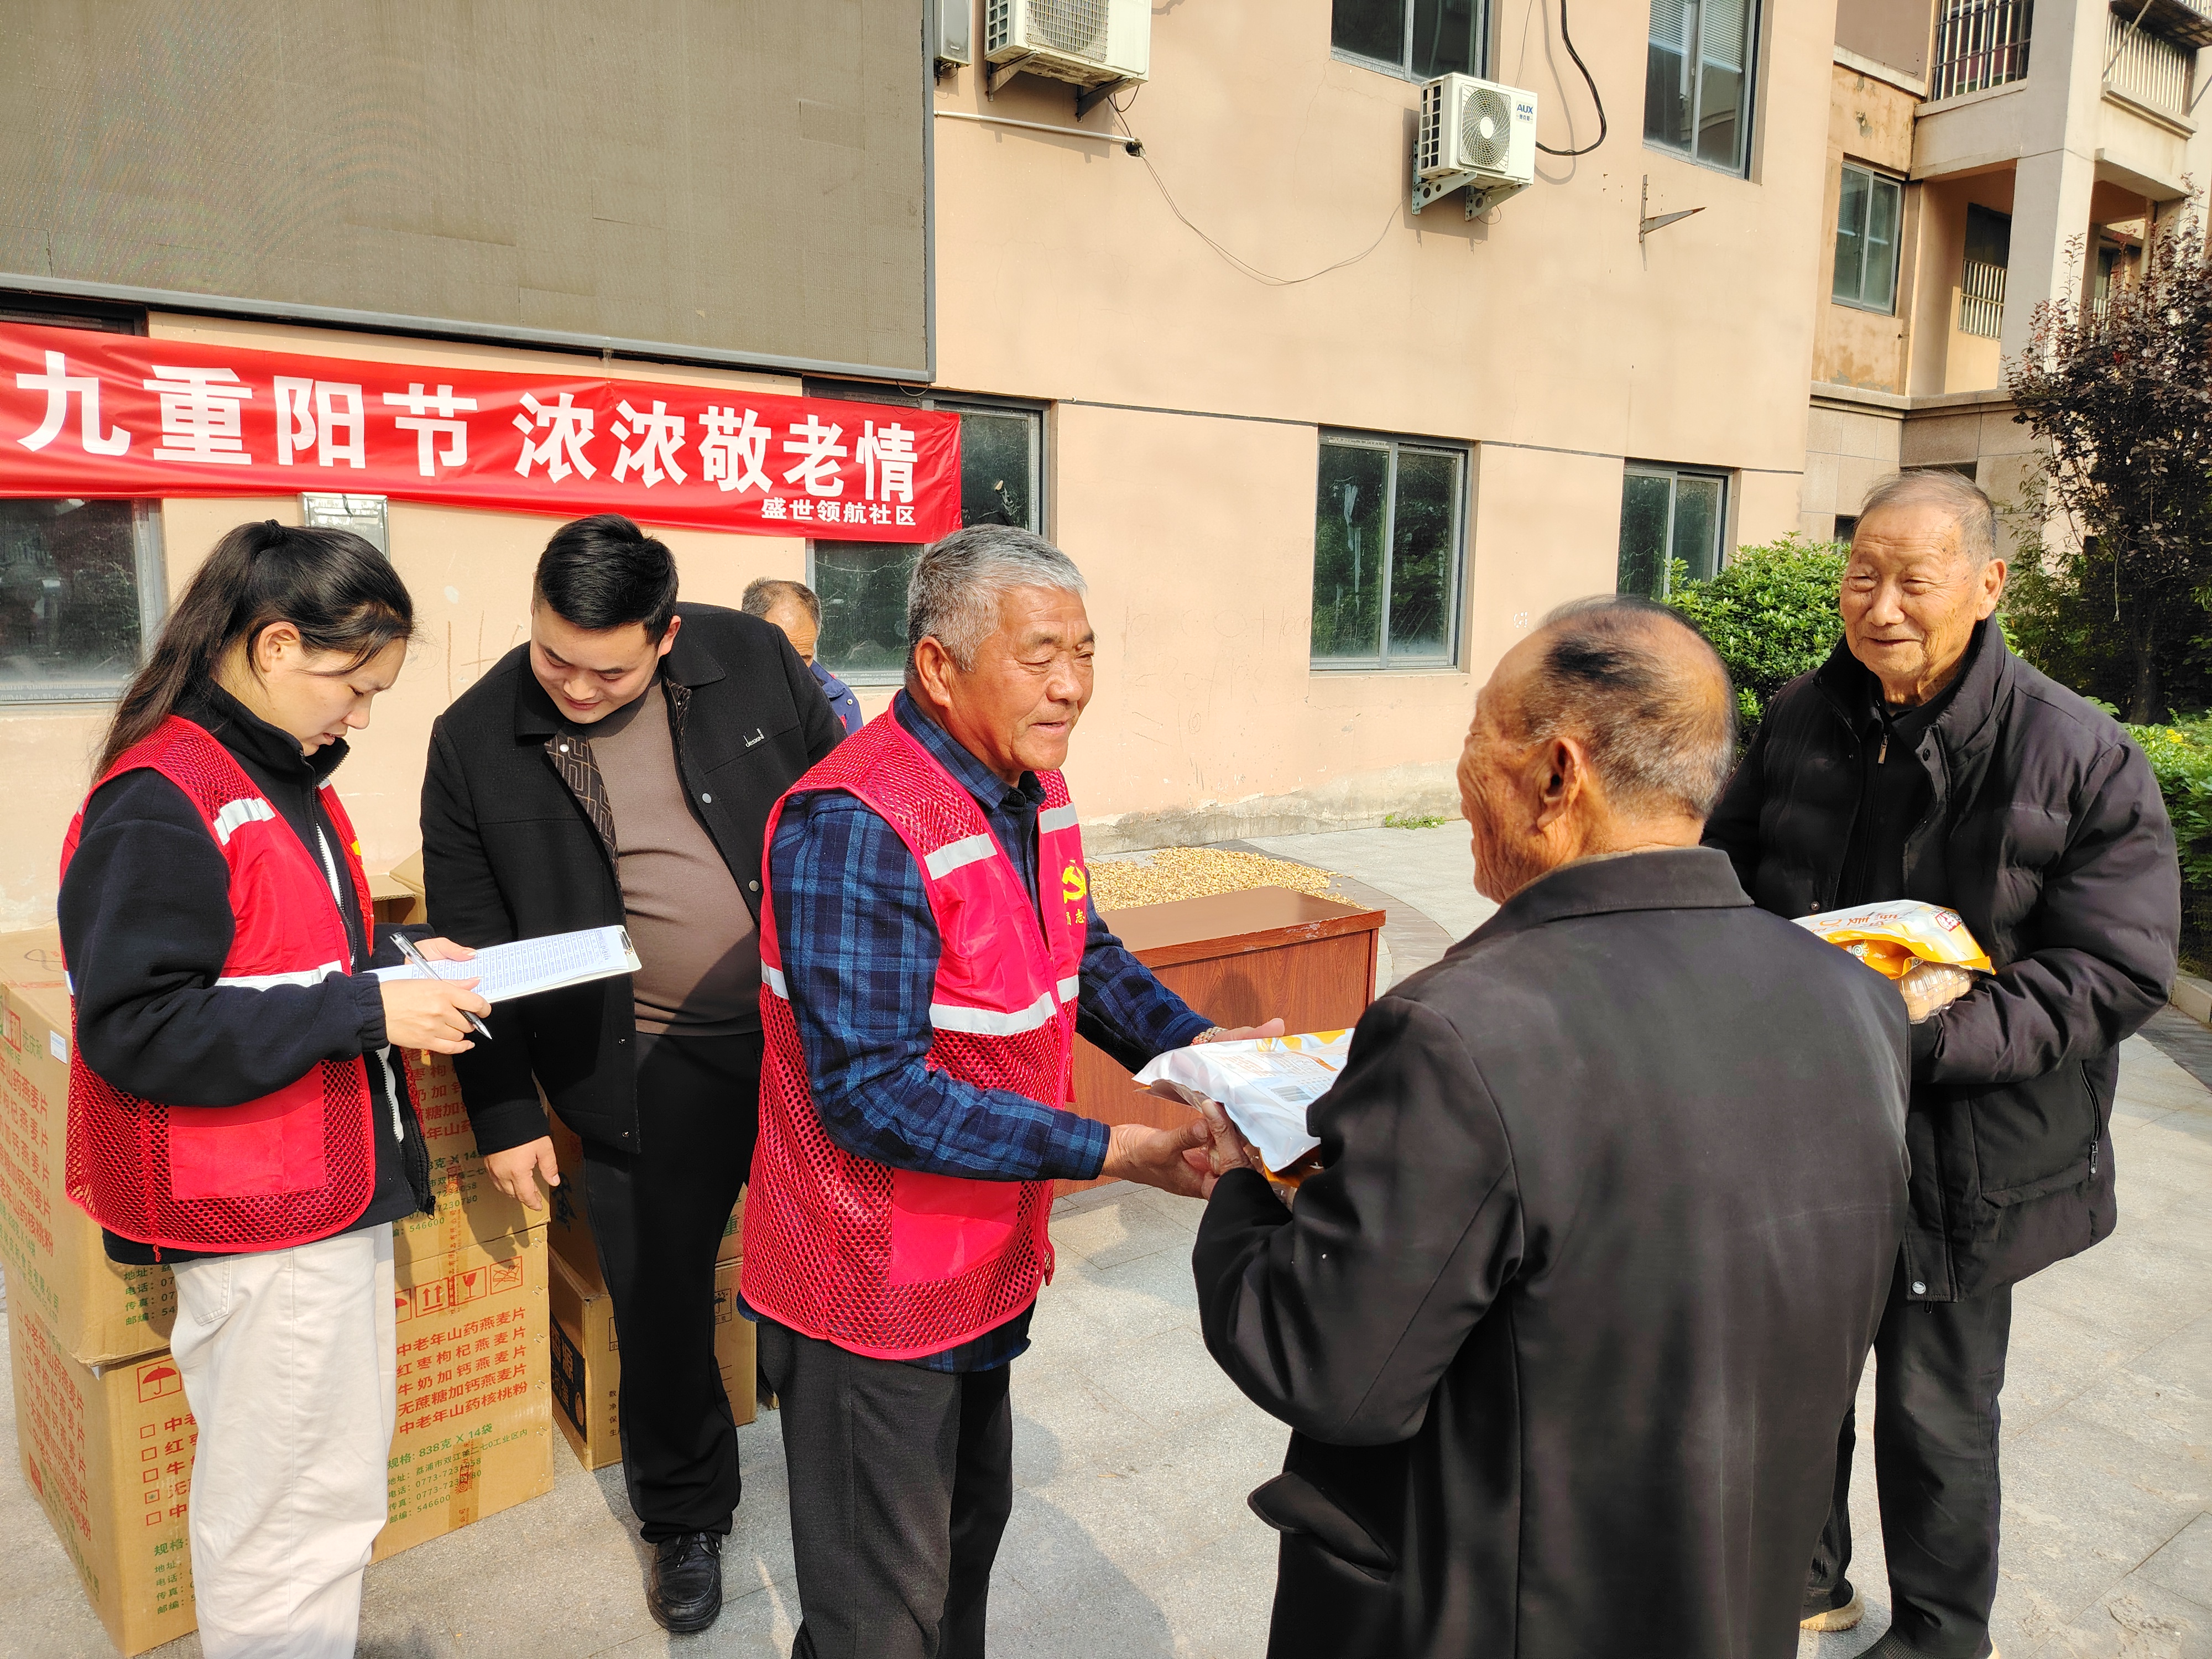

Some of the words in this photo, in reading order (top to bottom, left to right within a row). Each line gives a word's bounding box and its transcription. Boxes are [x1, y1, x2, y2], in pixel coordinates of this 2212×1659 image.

[1517, 104, 1533, 114] AUX
[16, 349, 478, 477] 九重阳节
[512, 390, 918, 504] 浓浓敬老情
[761, 497, 917, 526] 盛世领航社区
[0, 1084, 49, 1155] 枸杞燕麦片
[397, 1307, 525, 1357] 中老年山药燕麦片
[397, 1326, 526, 1378] 红枣枸杞燕麦片
[398, 1345, 526, 1396] 牛奶加钙燕麦片
[398, 1363, 526, 1417] 无蔗糖加钙燕麦片
[400, 1381, 528, 1434] 中老年山药核桃粉
[169, 1504, 187, 1518] 中
